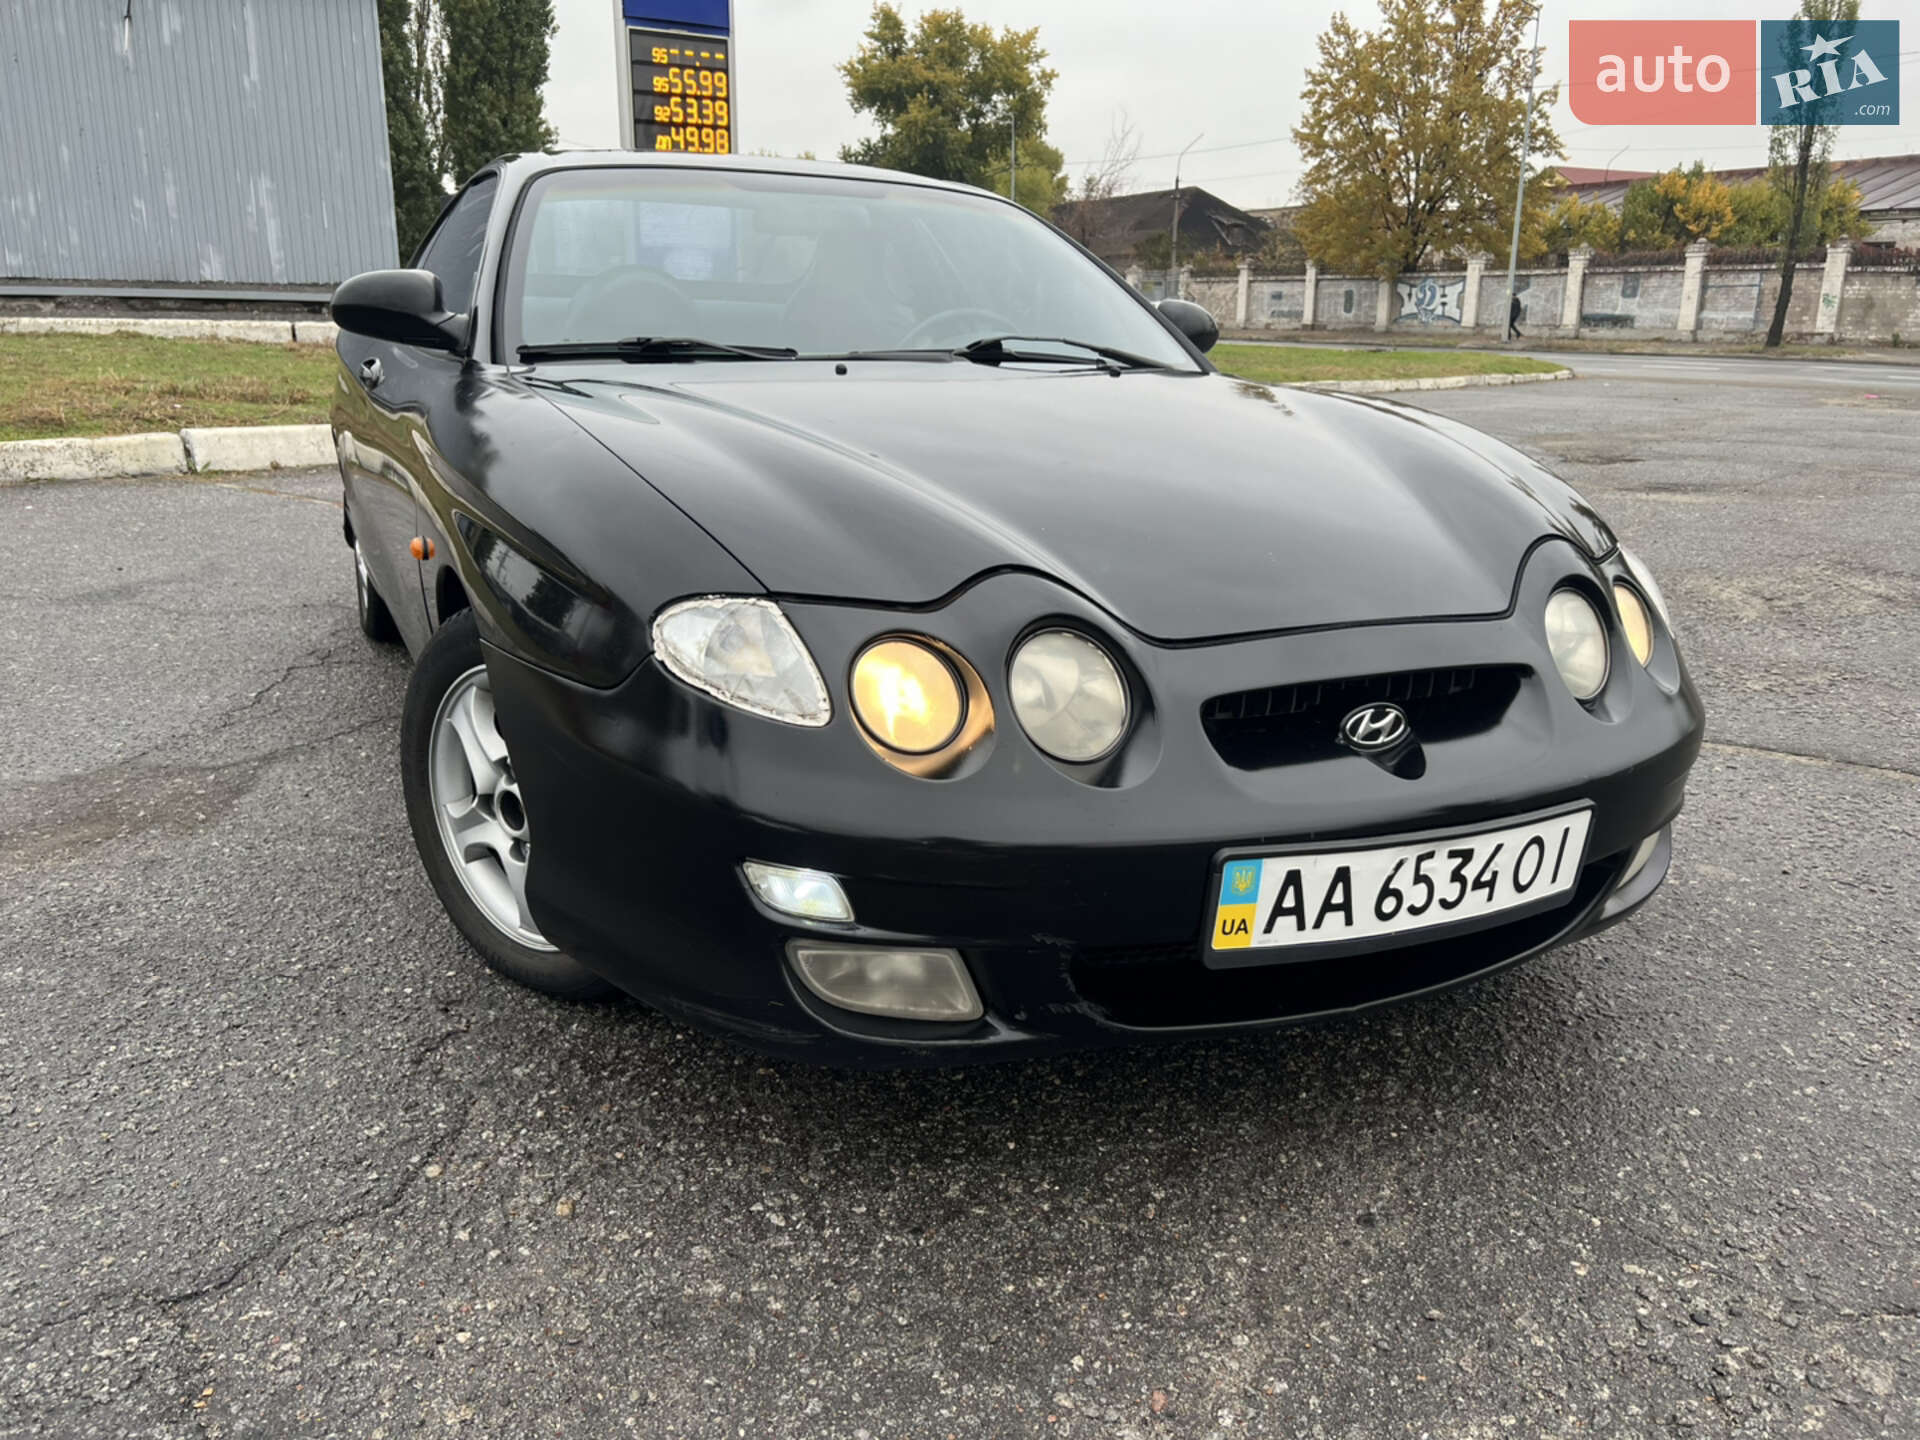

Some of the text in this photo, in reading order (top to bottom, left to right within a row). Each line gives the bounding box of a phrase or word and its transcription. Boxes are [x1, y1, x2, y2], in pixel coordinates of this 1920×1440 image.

[653, 67, 727, 98] 95 55.99
[670, 97, 728, 126] 53.39
[671, 126, 729, 154] 49.98
[1263, 865, 1354, 934] AA
[1374, 842, 1504, 921] 6534
[1222, 918, 1248, 935] UA
